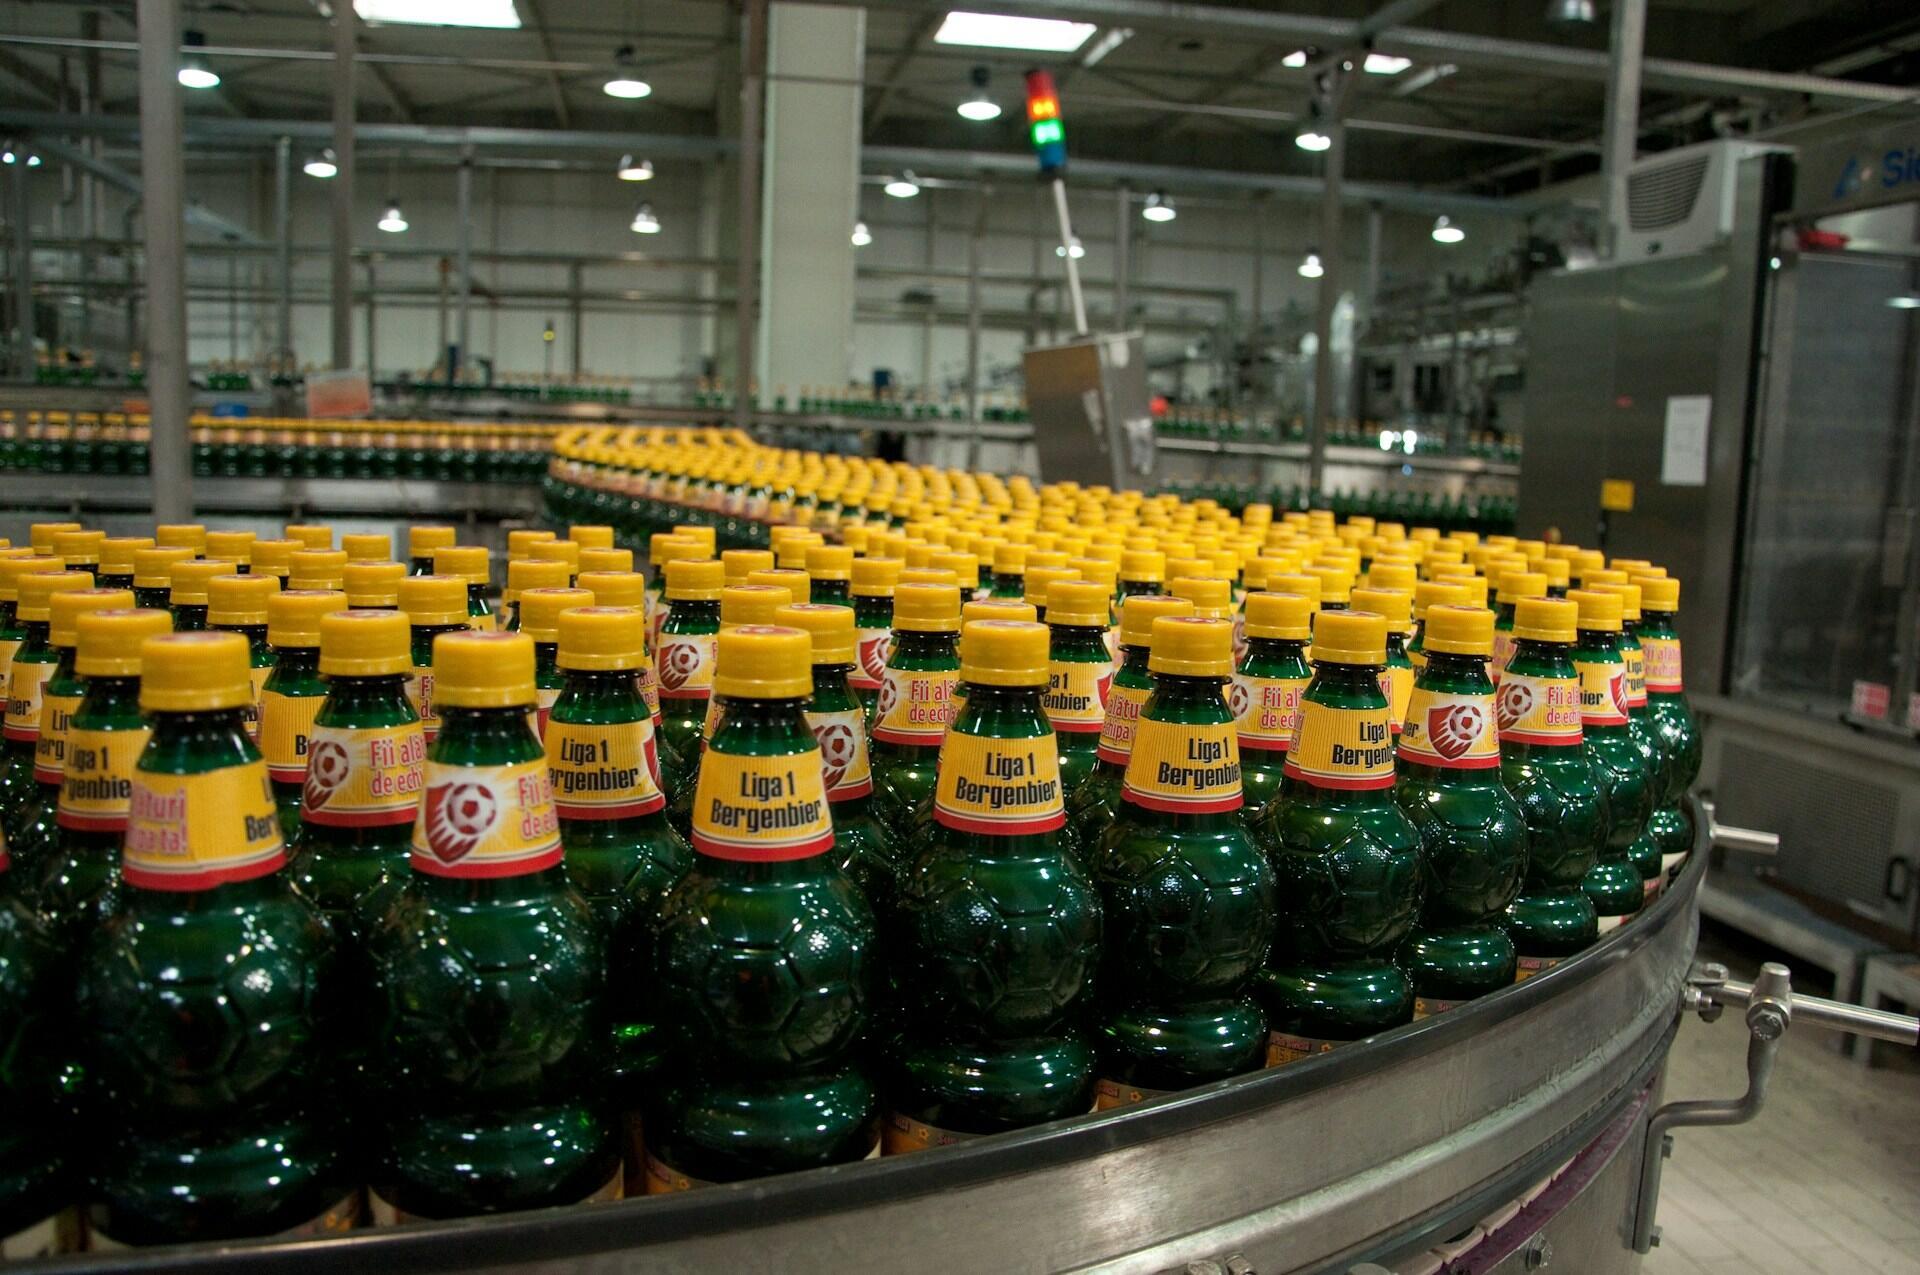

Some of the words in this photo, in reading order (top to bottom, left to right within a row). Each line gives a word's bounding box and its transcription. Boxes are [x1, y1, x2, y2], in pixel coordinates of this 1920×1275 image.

[911, 680, 930, 701] Fii
[1264, 687, 1281, 707] Fii
[1548, 686, 1564, 705] Fii
[910, 704, 929, 722] de
[1261, 710, 1276, 728] de
[1547, 708, 1560, 724] de
[1360, 722, 1385, 745] Liga
[101, 746, 109, 770] 1
[369, 740, 395, 769] Fii
[561, 737, 597, 766] Liga
[600, 738, 608, 762] 1
[1188, 737, 1221, 764] Liga
[1223, 736, 1230, 758] 1
[985, 752, 1025, 781] Liga
[1028, 752, 1035, 774] 1
[370, 769, 393, 797] de
[517, 774, 541, 807] Fii
[740, 771, 781, 803] Liga
[788, 770, 796, 796] 1
[955, 775, 1057, 809] Bergenbier
[521, 812, 543, 840] de
[710, 797, 822, 833] Bergenbier
